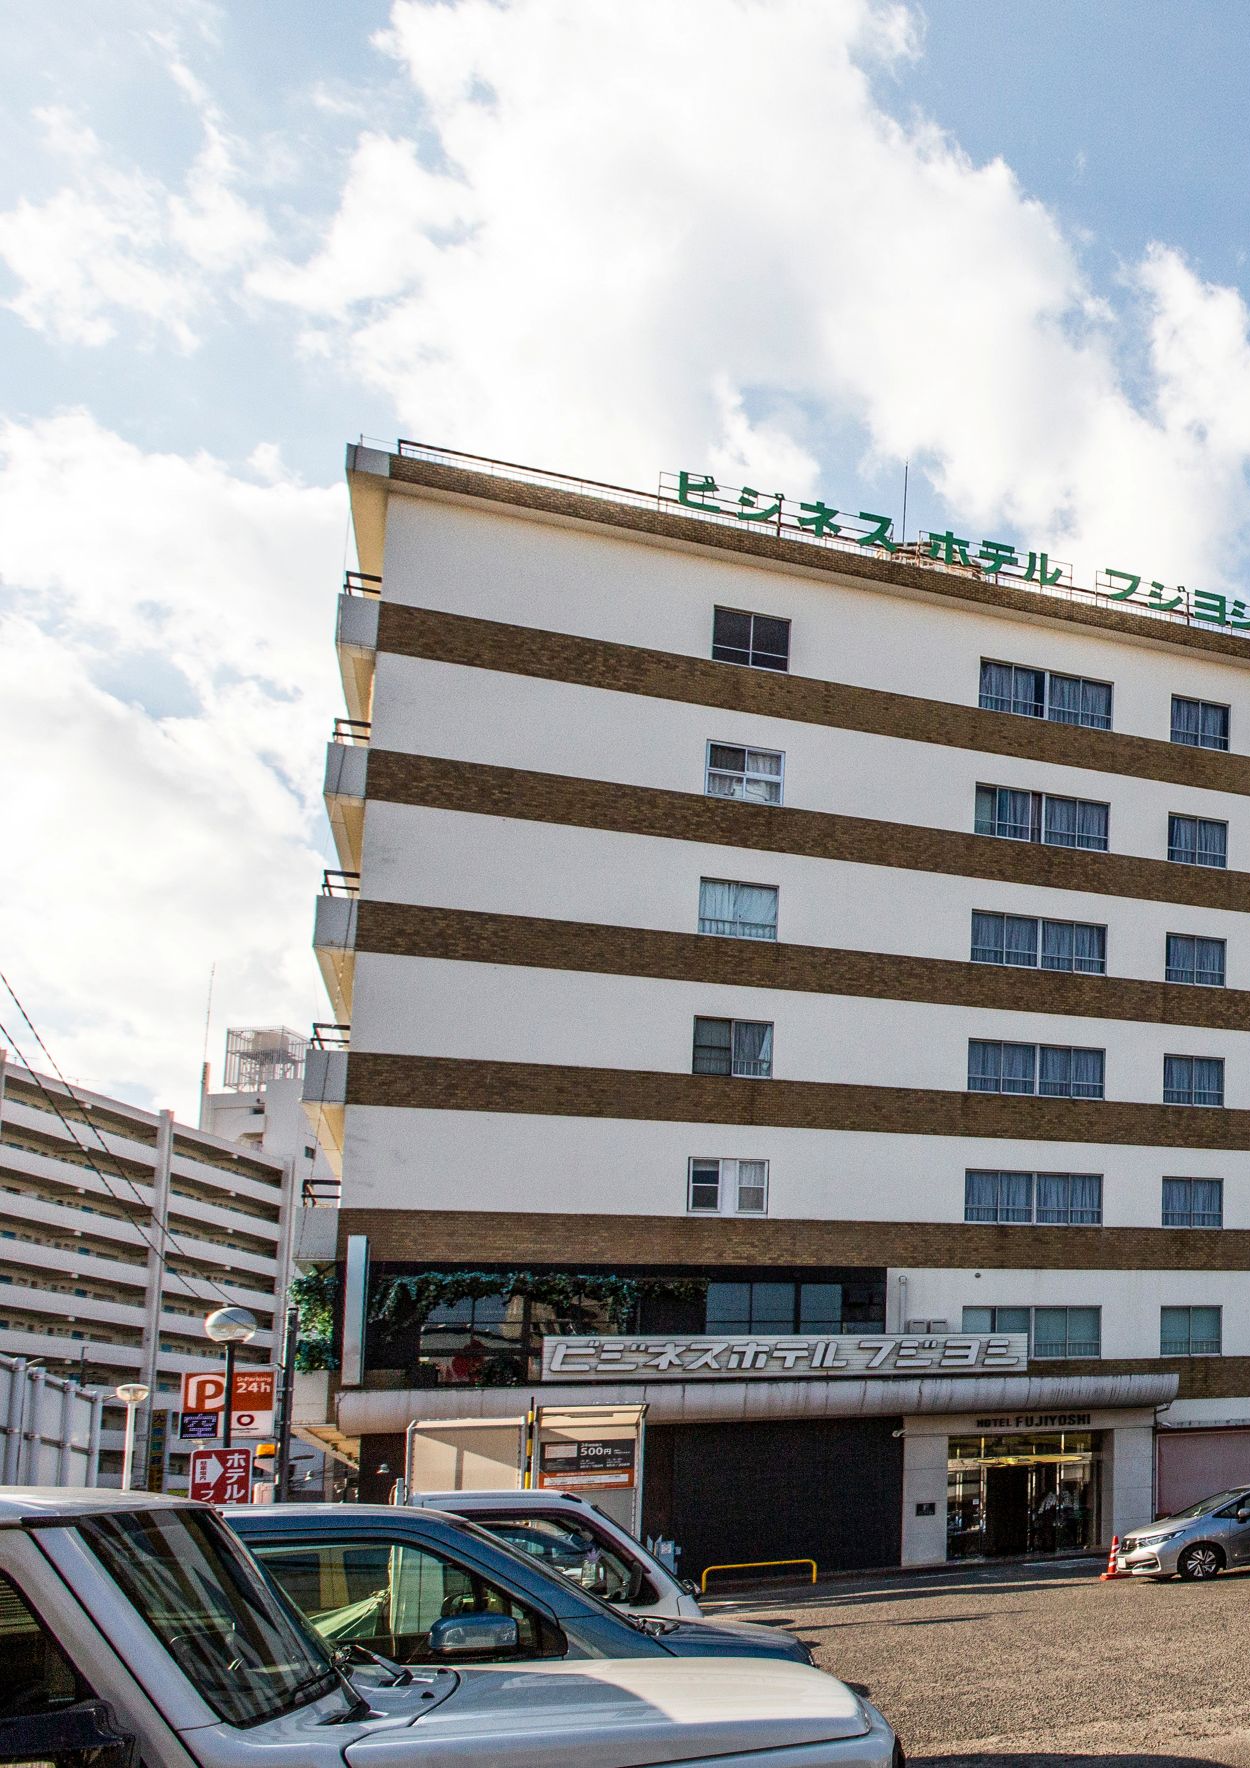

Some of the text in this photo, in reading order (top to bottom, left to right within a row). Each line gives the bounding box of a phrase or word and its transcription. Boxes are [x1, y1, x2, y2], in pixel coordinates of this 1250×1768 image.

[679, 471, 898, 552] ビジネス
[929, 531, 1063, 587] ホテル
[236, 1382, 271, 1393] 24h
[976, 1413, 1091, 1428] HOTEL FUJIYOSHI
[580, 1446, 612, 1456] 500円
